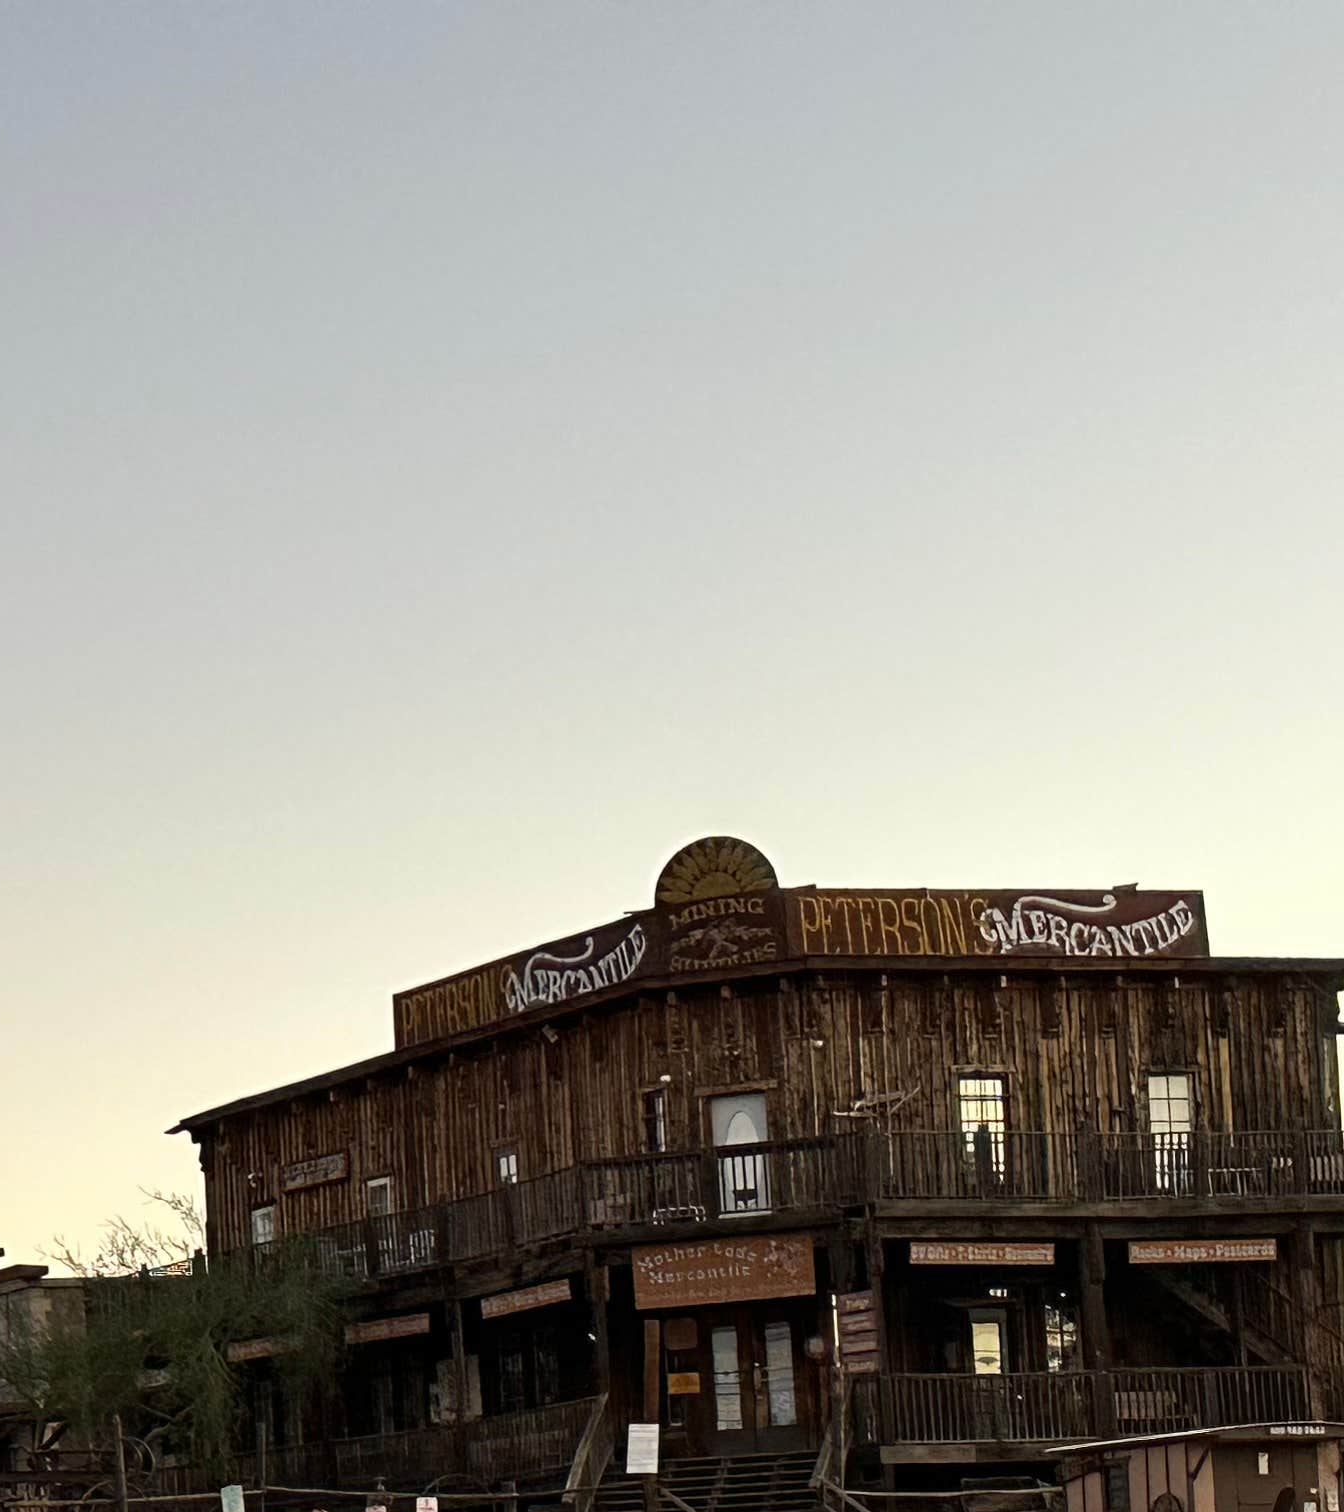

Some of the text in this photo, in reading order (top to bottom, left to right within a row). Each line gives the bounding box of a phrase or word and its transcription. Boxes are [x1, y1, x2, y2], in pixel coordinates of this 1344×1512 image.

[669, 898, 765, 931] MINING
[981, 894, 1194, 956] MERCANTILE
[505, 924, 646, 1012] MERCANTILE
